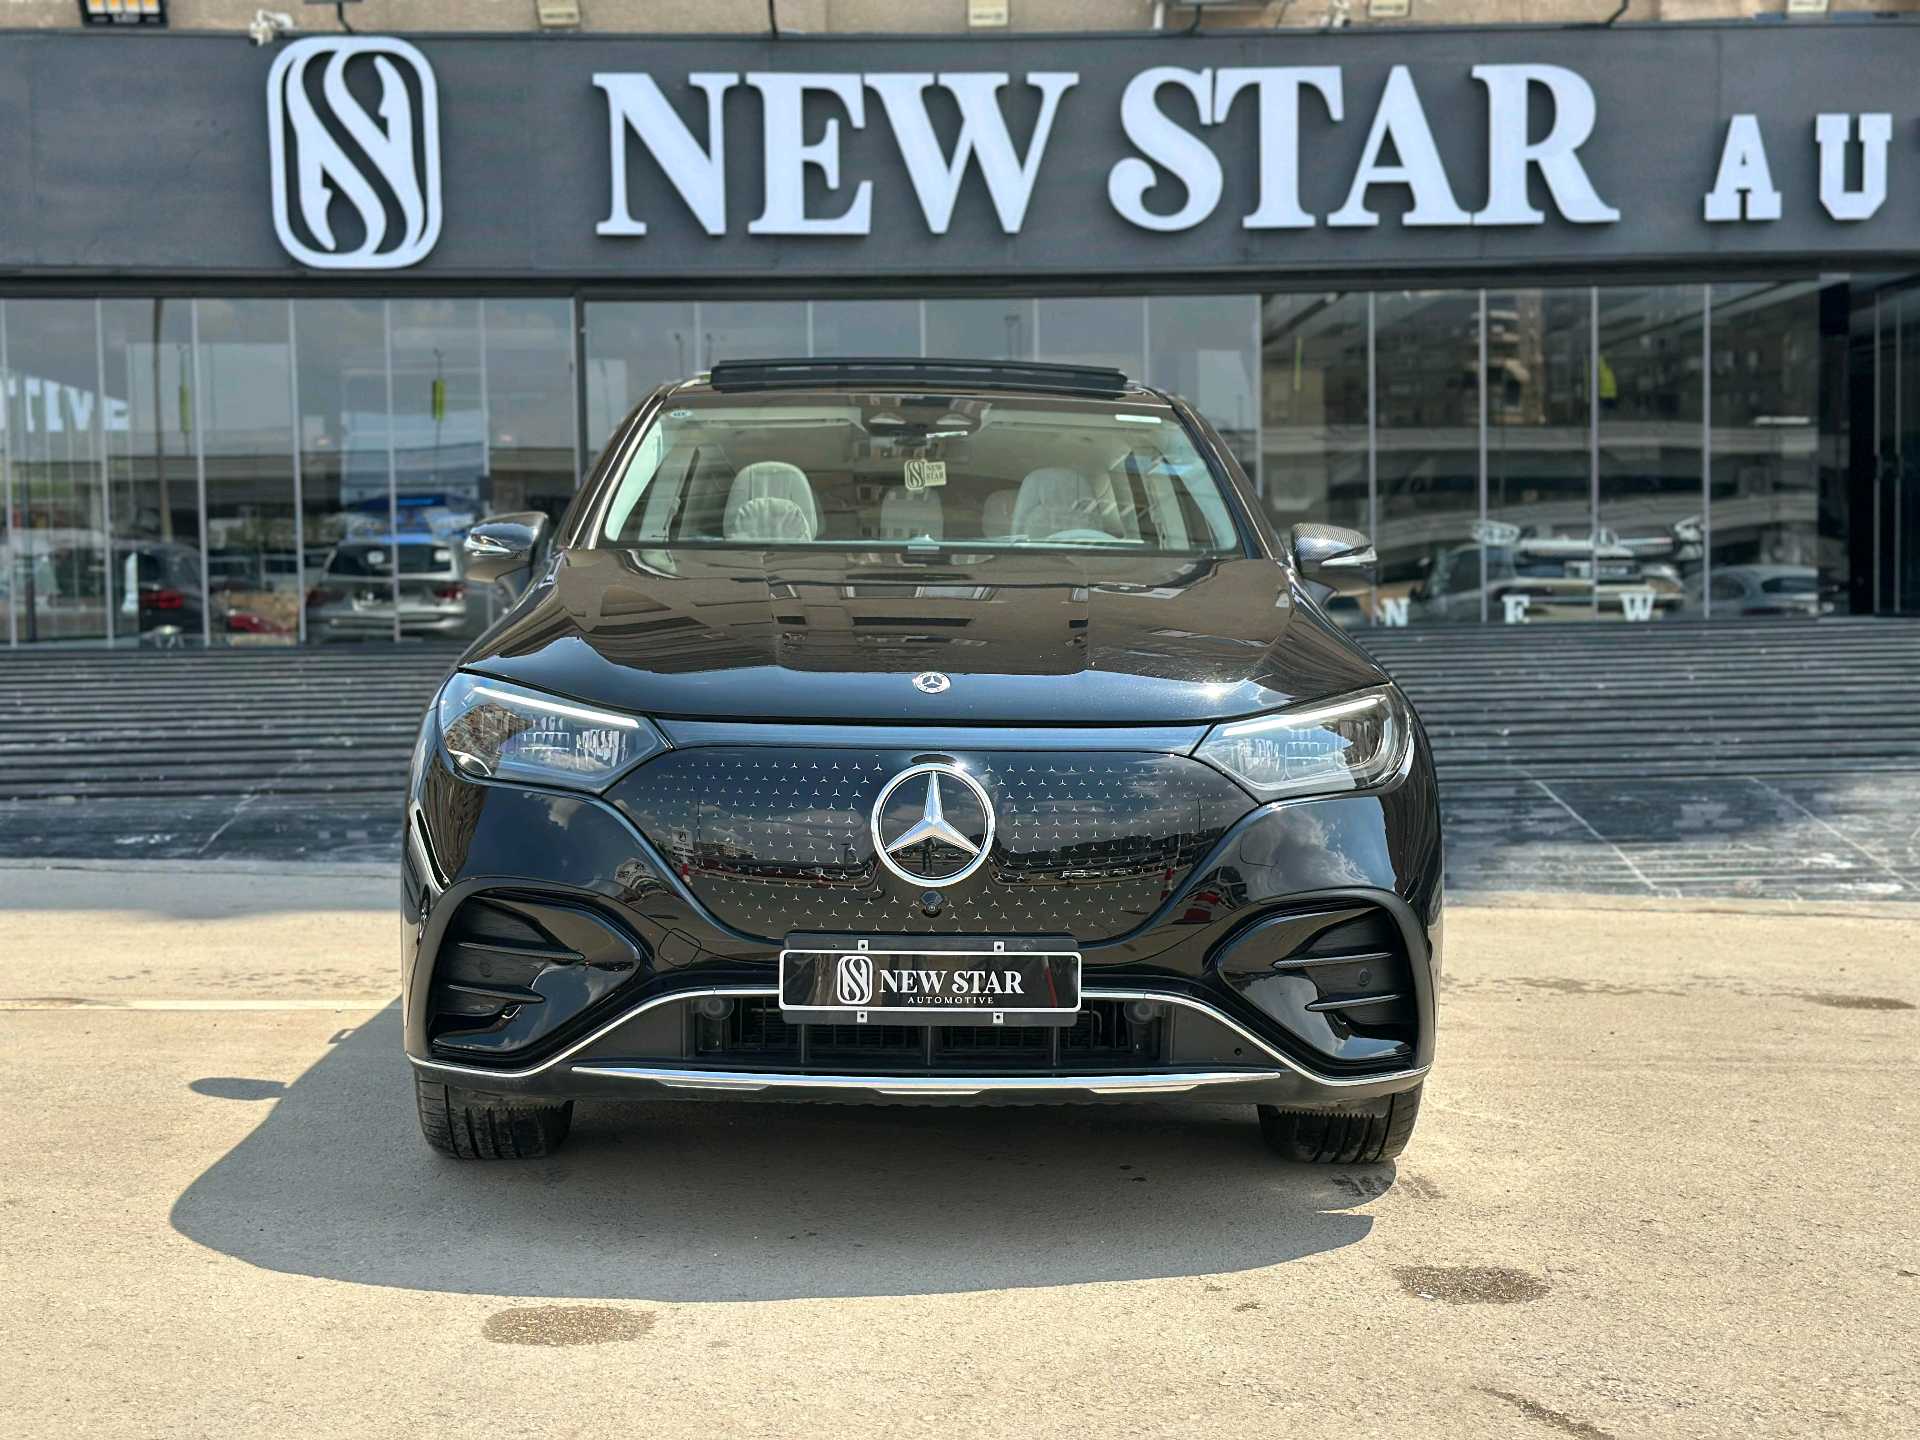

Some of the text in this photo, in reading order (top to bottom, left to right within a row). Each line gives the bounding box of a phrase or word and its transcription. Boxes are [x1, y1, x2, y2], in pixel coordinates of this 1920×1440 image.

[593, 72, 1079, 235] NEW
[1108, 64, 1620, 232] STAR
[879, 970, 947, 994] NEW
[951, 970, 1025, 994] STAR
[907, 996, 994, 1005] AUTOMOTIVE
